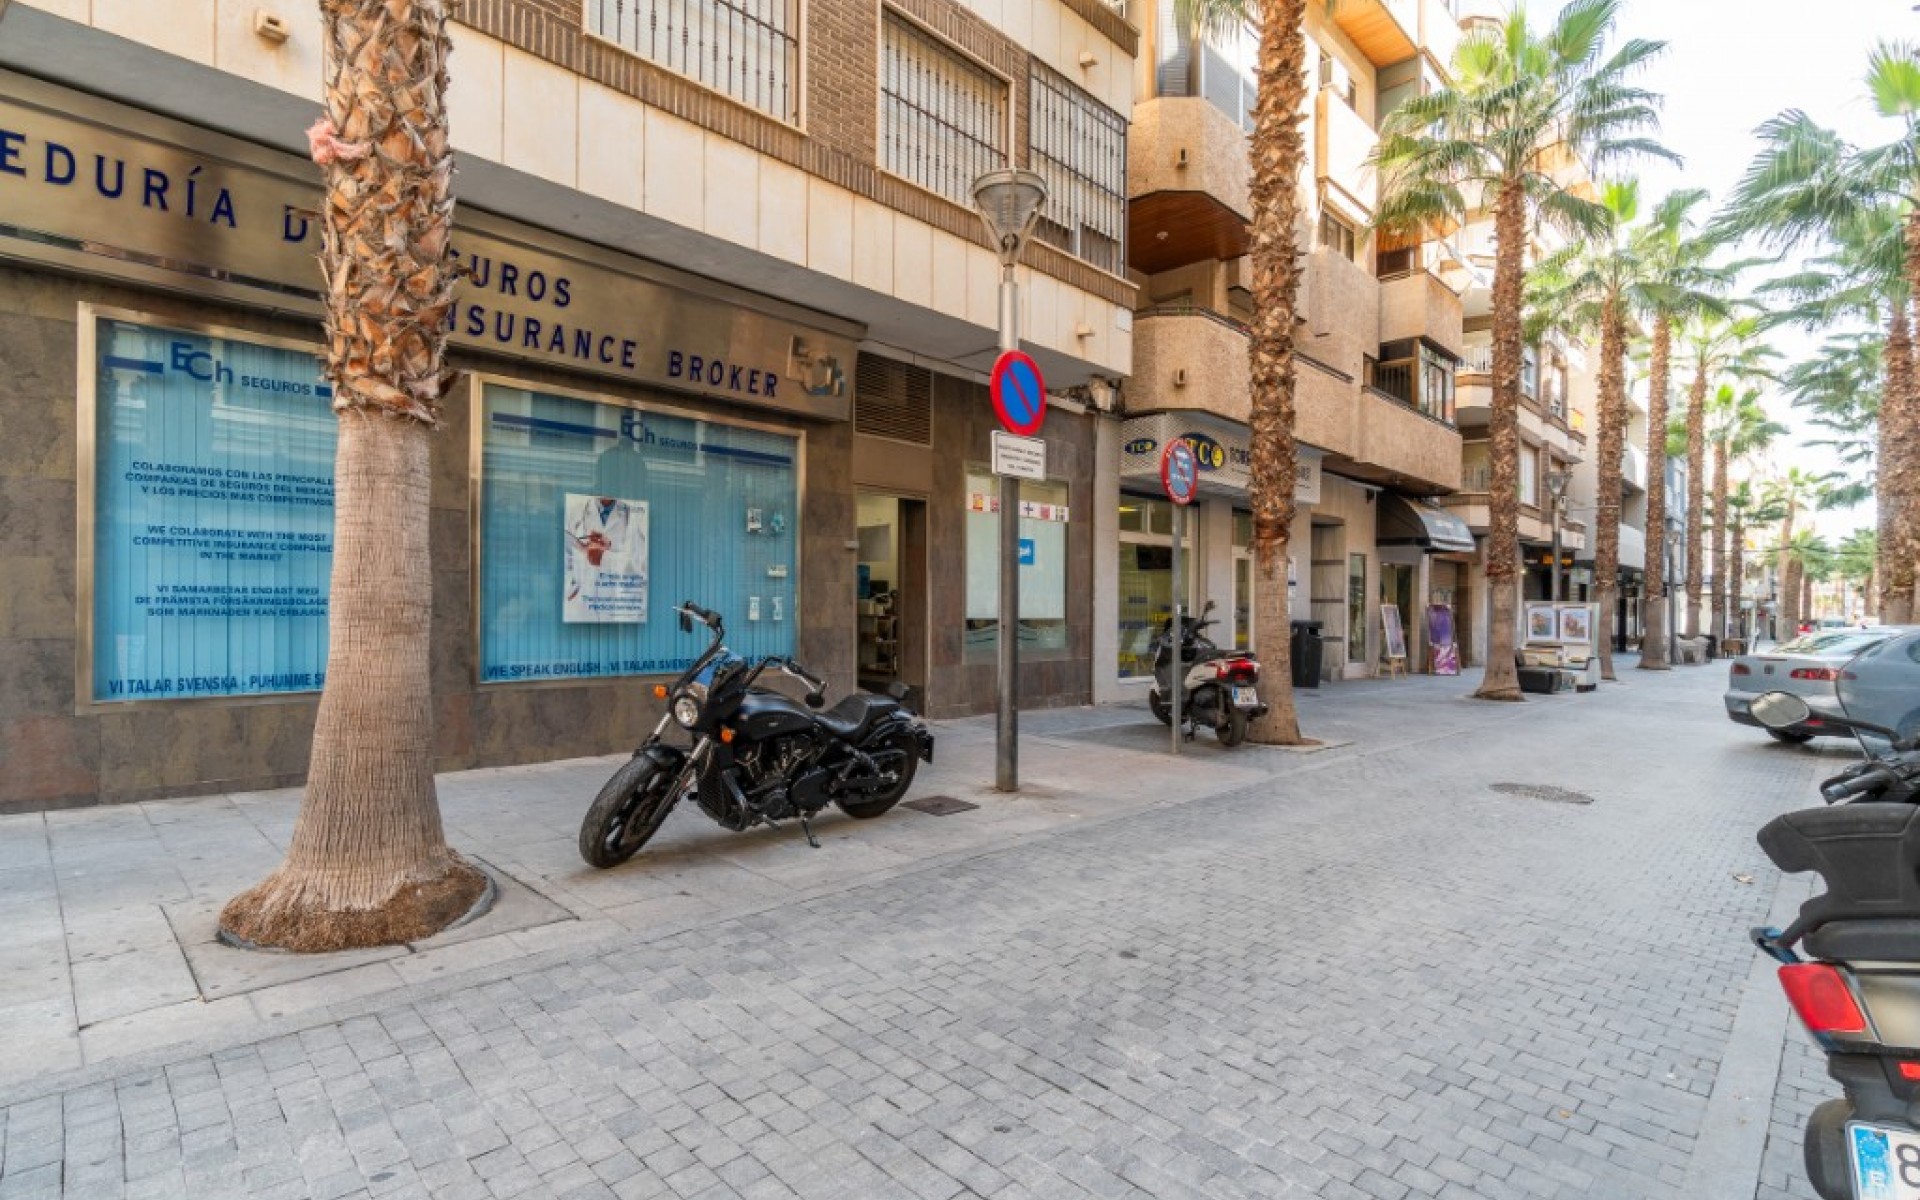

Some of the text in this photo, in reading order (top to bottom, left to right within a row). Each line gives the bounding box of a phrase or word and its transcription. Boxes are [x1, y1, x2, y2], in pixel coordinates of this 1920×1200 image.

[449, 248, 571, 308] UROS
[668, 351, 778, 397] BROKER
[241, 375, 312, 396] SEGUROS
[659, 437, 698, 450] SEGUROS
[132, 461, 223, 478] COLABORAMOS
[226, 469, 249, 479] CON
[253, 471, 273, 481] LAS
[140, 485, 149, 494] Y
[153, 486, 176, 497] LOS
[178, 487, 228, 500] PRECIOS
[201, 478, 216, 488] DE
[219, 480, 271, 492] SEGUROS
[147, 525, 166, 535] WE
[247, 530, 273, 540] WITH
[276, 531, 296, 540] THE
[297, 532, 327, 542] MOST
[132, 536, 210, 548] COMPETITIVE
[213, 540, 278, 552] INSURANCE
[200, 551, 283, 561] IN THE MARKET
[156, 585, 170, 593] VI
[134, 596, 152, 605] DE
[147, 607, 175, 617] SOM
[254, 608, 277, 617] KAN
[487, 664, 508, 677] WE
[509, 663, 550, 677] SPEAK
[552, 661, 601, 675] ENGLISH
[610, 660, 620, 671] VI
[623, 660, 656, 671] TALAR
[109, 679, 124, 695] VI
[128, 678, 172, 694] TALAR
[177, 675, 238, 692] SVENSKA
[250, 672, 311, 689] PUHUMME
